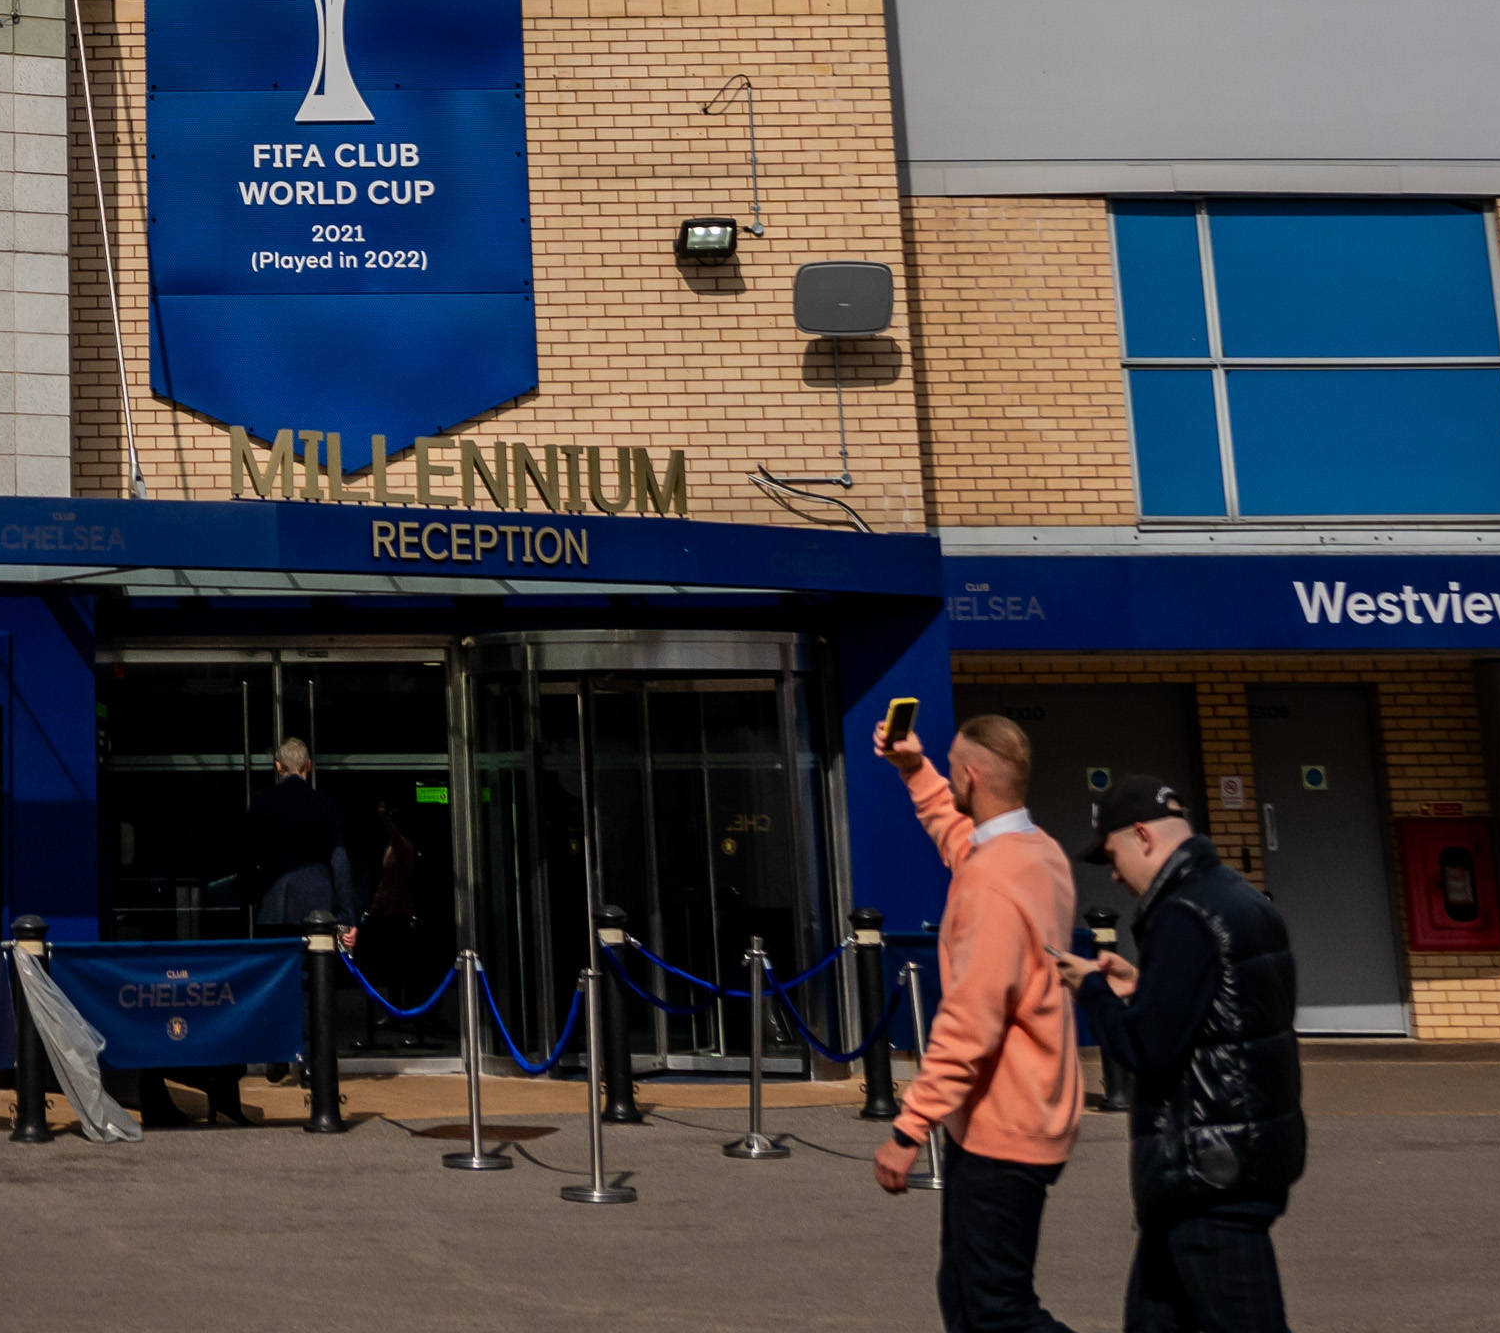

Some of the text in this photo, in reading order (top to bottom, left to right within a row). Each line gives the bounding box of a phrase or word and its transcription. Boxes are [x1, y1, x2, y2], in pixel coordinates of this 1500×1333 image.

[254, 144, 419, 167] FIFA CLUB
[239, 181, 434, 205] WORLD CUP
[312, 225, 365, 242] 2021
[252, 251, 427, 272] (Played in 2022)
[230, 425, 688, 514] MILLENNIUM
[2, 523, 126, 552] CHELSEA
[372, 520, 590, 566] RECEPTION
[965, 583, 990, 592] CLUB
[946, 596, 1046, 621] ELSEA
[166, 969, 189, 980] CLUB
[118, 982, 236, 1009] CHELSEA
